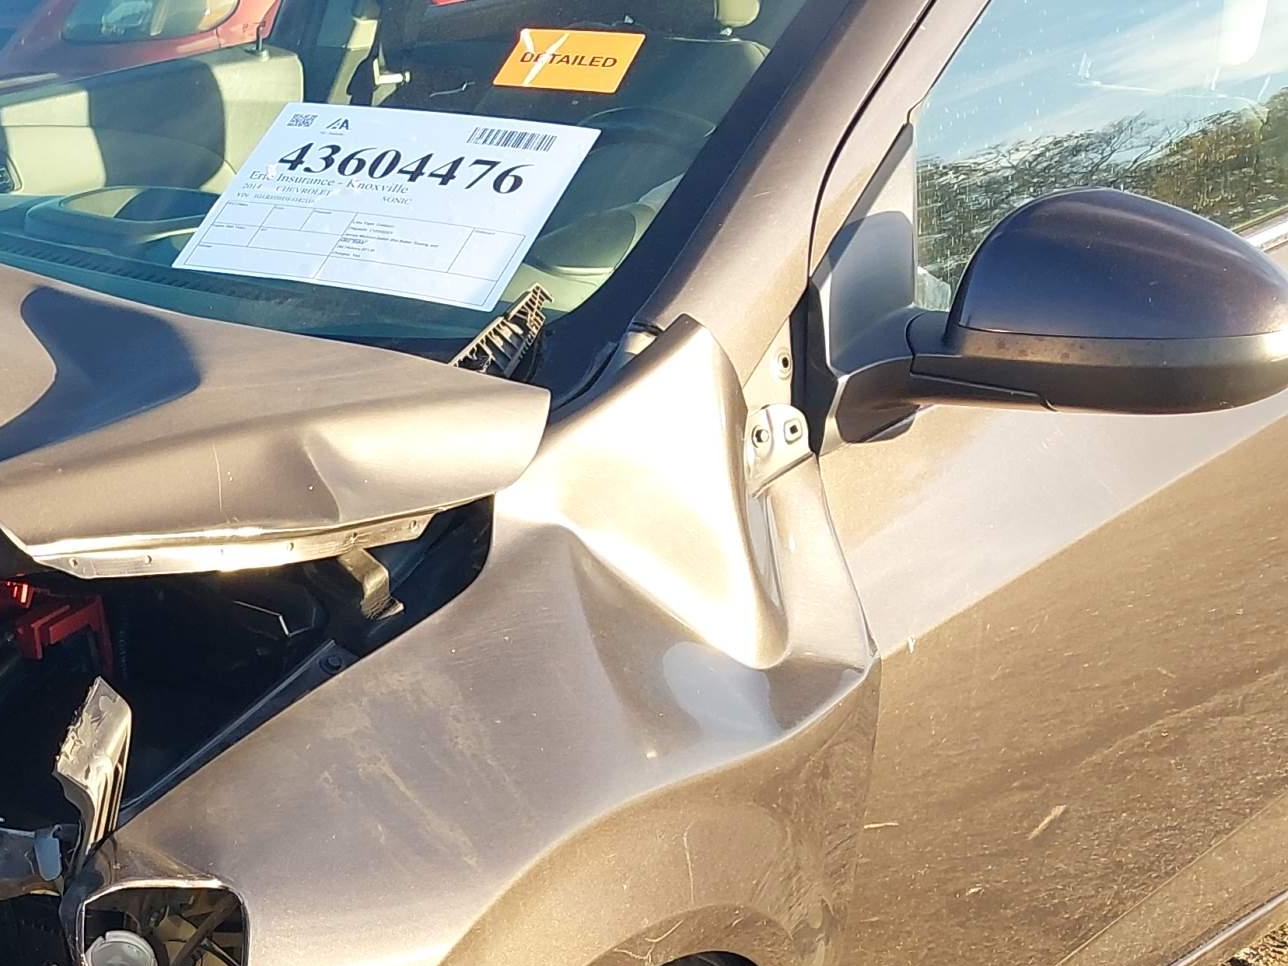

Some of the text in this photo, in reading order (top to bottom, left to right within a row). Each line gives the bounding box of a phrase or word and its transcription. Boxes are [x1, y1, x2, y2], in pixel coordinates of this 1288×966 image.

[520, 51, 618, 68] DETAILED
[278, 142, 537, 195] 43604476
[276, 173, 336, 187] Insurance
[346, 179, 410, 194] Knoxville
